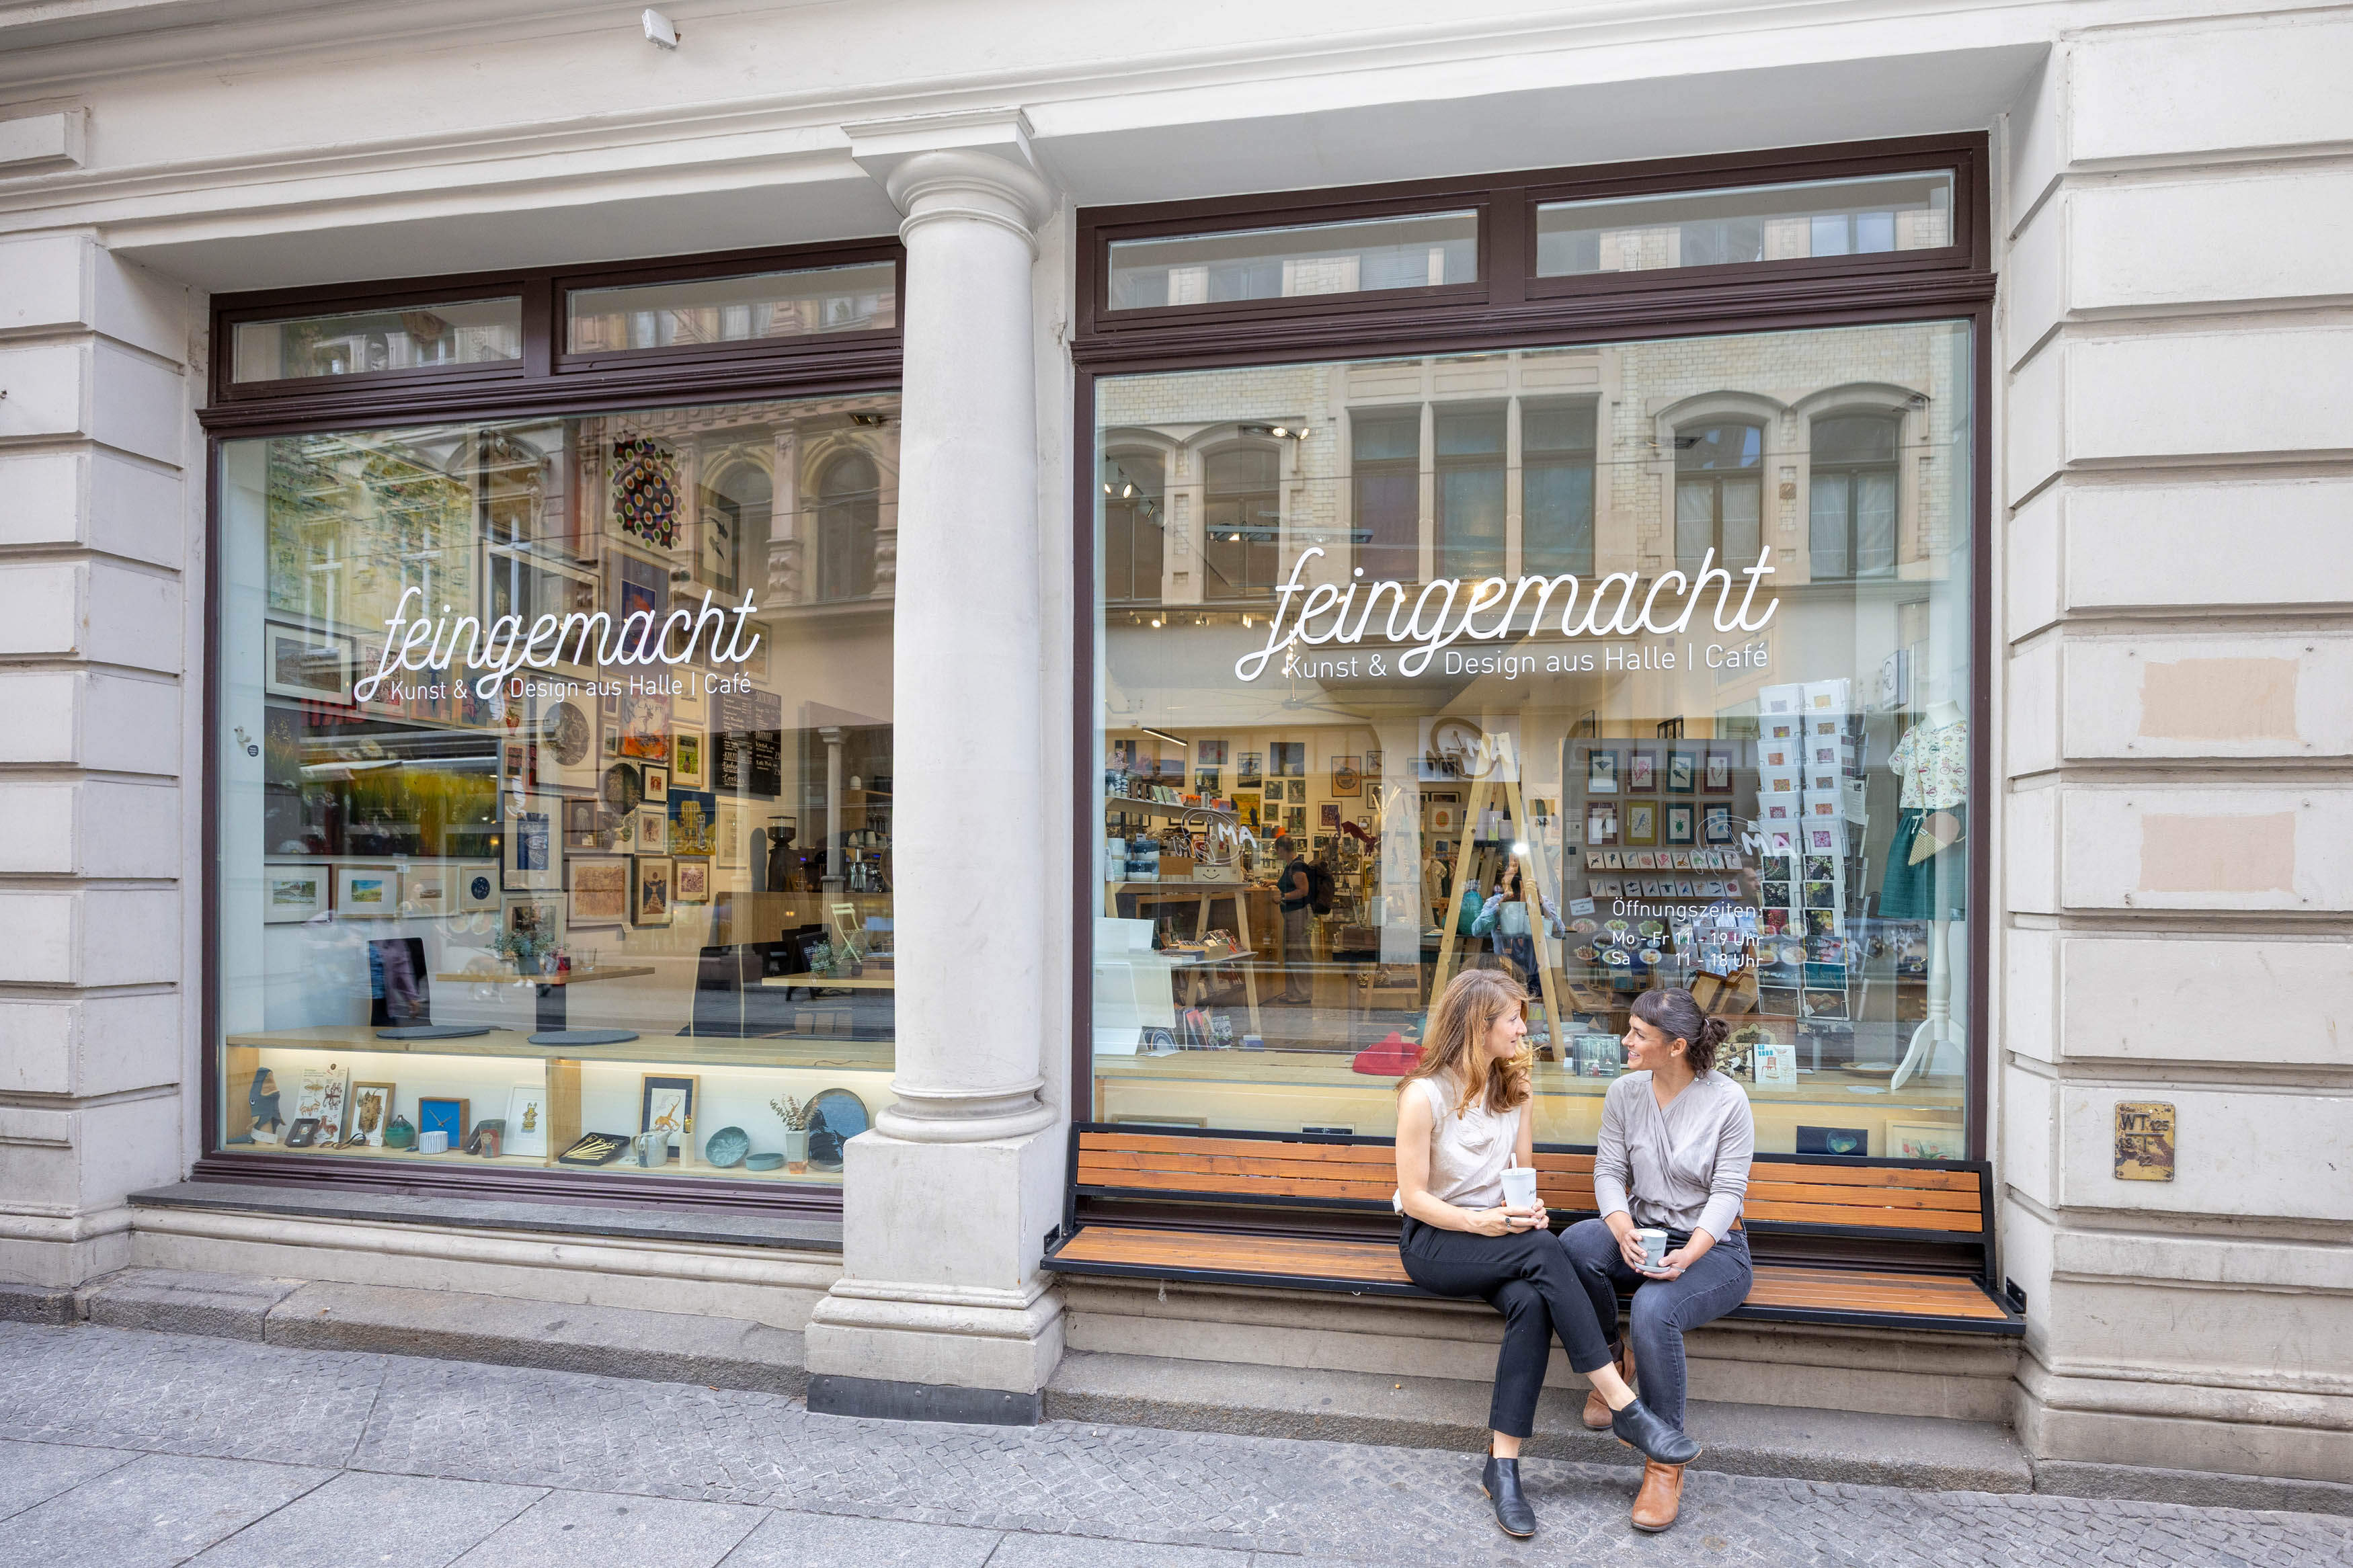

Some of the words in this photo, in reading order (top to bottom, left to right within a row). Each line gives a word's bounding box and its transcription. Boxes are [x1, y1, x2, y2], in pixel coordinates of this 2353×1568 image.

[1234, 546, 1780, 682] feingemacht
[354, 586, 760, 702] feingemacht
[1286, 655, 1358, 678] Kunst
[1369, 654, 1386, 677] &
[1445, 651, 1536, 680] Design
[1546, 655, 1594, 672] aus
[1605, 646, 1676, 671] Halle
[1705, 642, 1768, 669] Café
[391, 681, 446, 700] Kunst
[453, 679, 467, 699] &
[511, 677, 578, 703] Design
[586, 681, 622, 696] aus
[630, 674, 682, 695] Halle
[705, 671, 751, 694] Café
[1613, 897, 1763, 922] Öffnungszeiten:
[1612, 931, 1635, 944] Mo
[1653, 932, 1669, 945] Fr
[1675, 932, 1691, 946] 11
[1710, 932, 1728, 946] 19
[1734, 933, 1764, 947] Uhr
[1611, 951, 1630, 965] Sa
[1675, 952, 1691, 966] 11
[1710, 952, 1728, 967] 18
[1734, 954, 1764, 968] Uhr
[2120, 1113, 2150, 1130] WT
